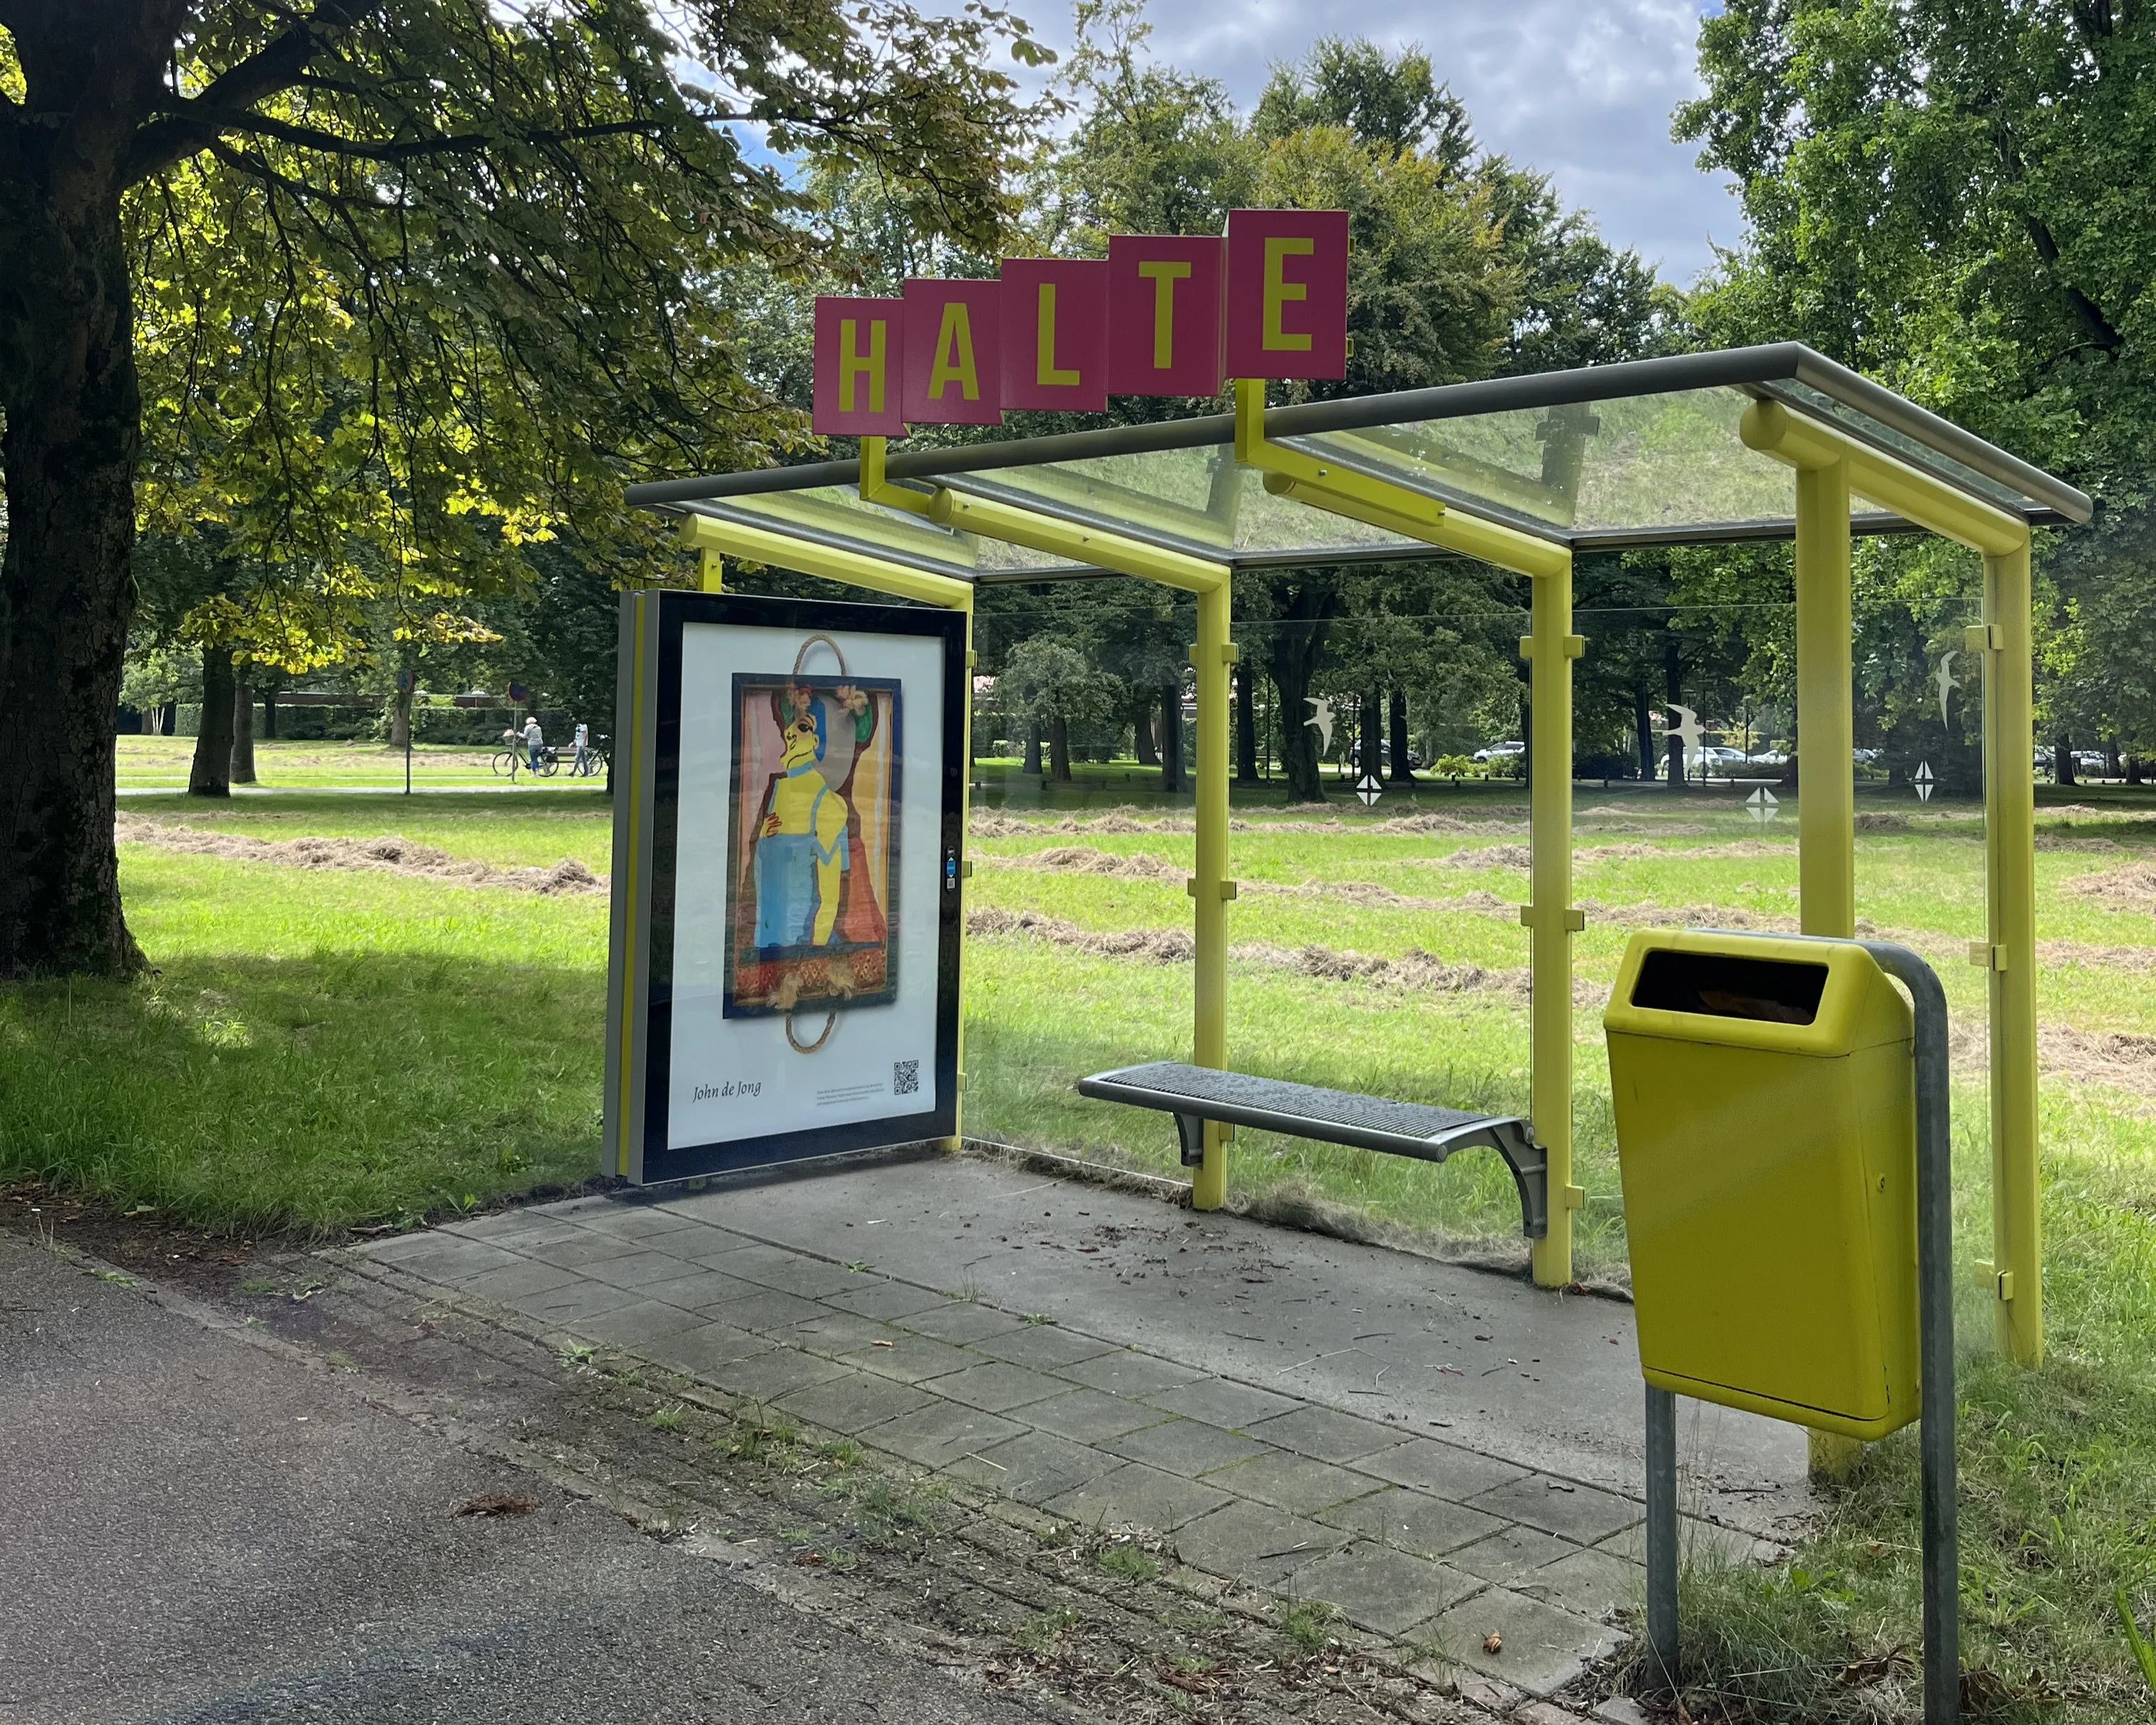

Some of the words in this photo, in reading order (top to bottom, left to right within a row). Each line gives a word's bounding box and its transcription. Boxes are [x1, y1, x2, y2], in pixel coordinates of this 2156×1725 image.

[838, 237, 1314, 413] HALTE
[692, 1084, 719, 1103] John
[722, 1081, 734, 1097] de
[736, 1081, 762, 1097] Jong
